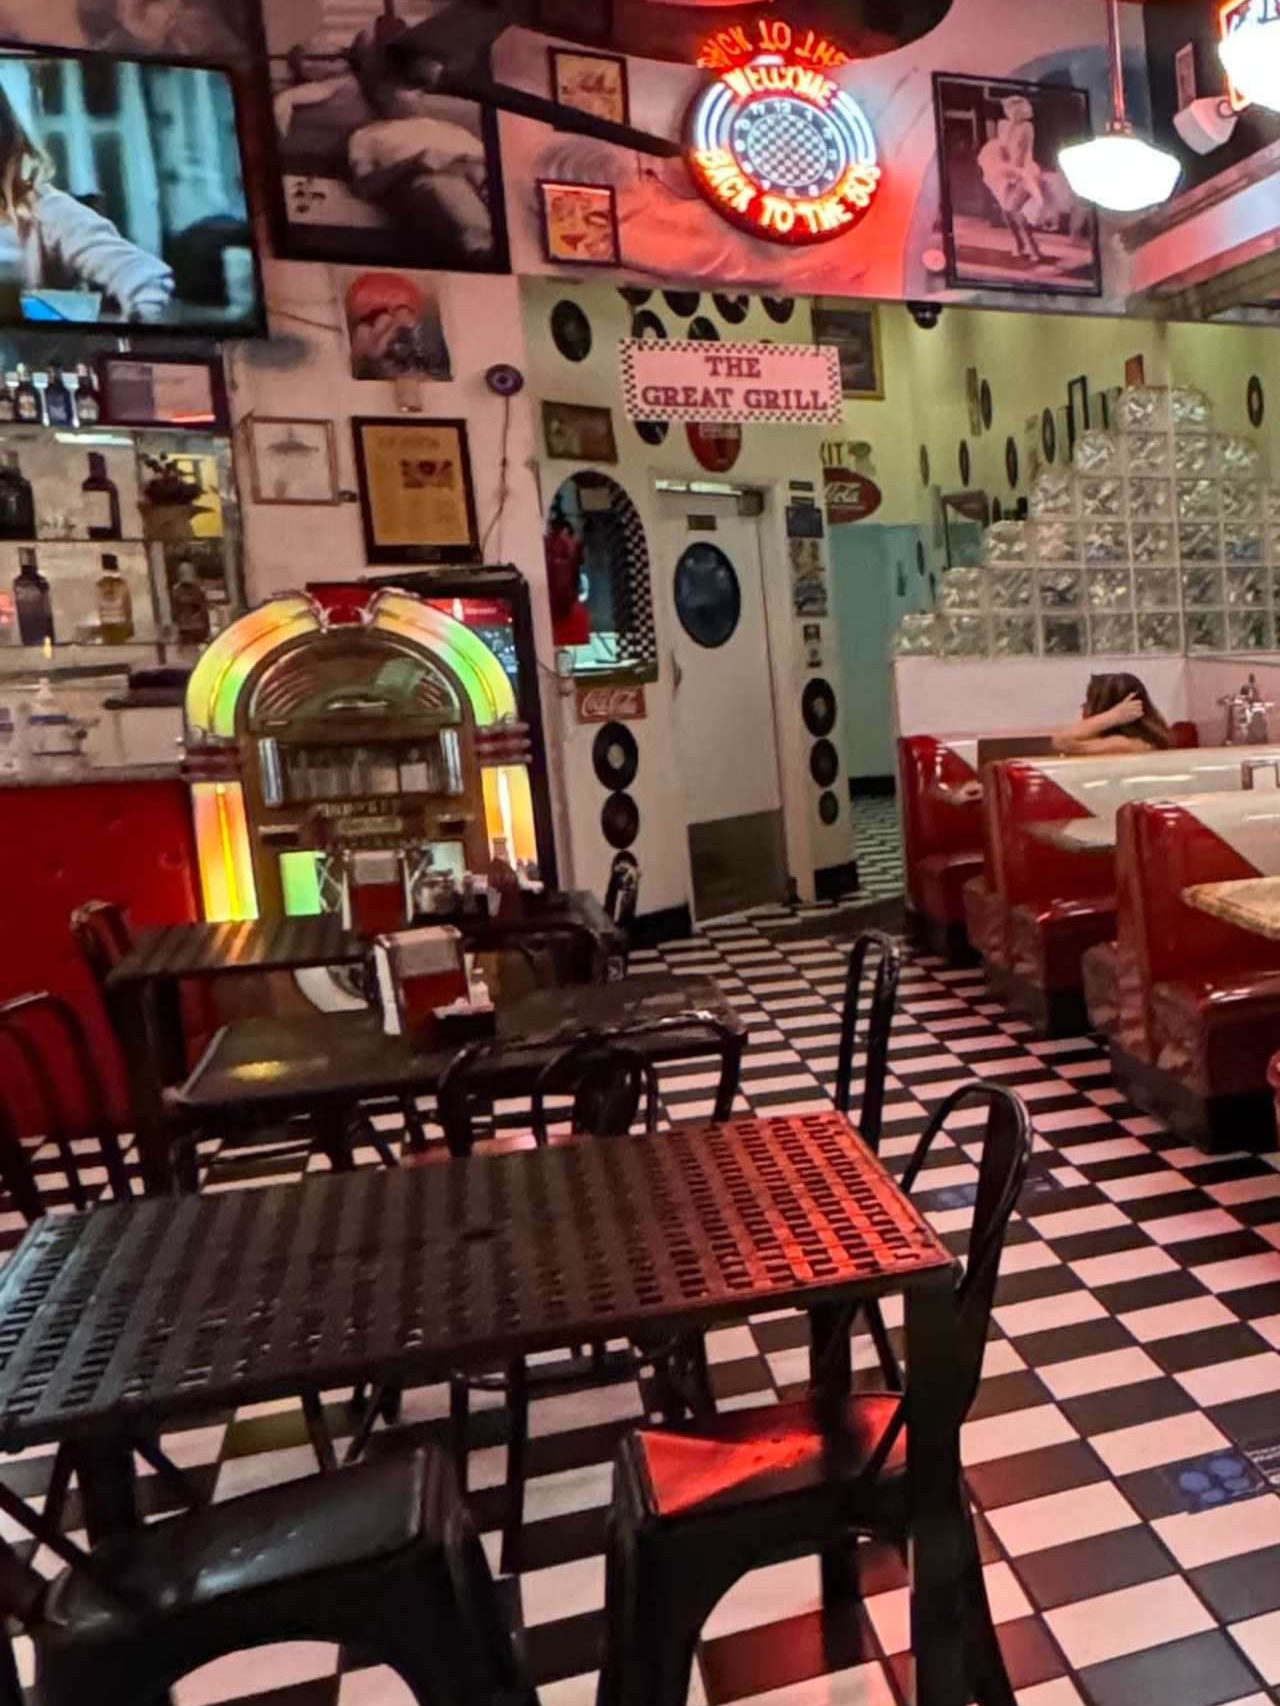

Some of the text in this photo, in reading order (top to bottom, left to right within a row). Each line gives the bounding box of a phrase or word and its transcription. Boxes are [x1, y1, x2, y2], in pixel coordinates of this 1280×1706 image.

[721, 65, 838, 108] WELCOME
[694, 147, 758, 215] BACK
[759, 195, 795, 233] TO
[794, 194, 854, 234] THE
[704, 355, 762, 379] THE
[640, 385, 829, 411] GREAT GRILL
